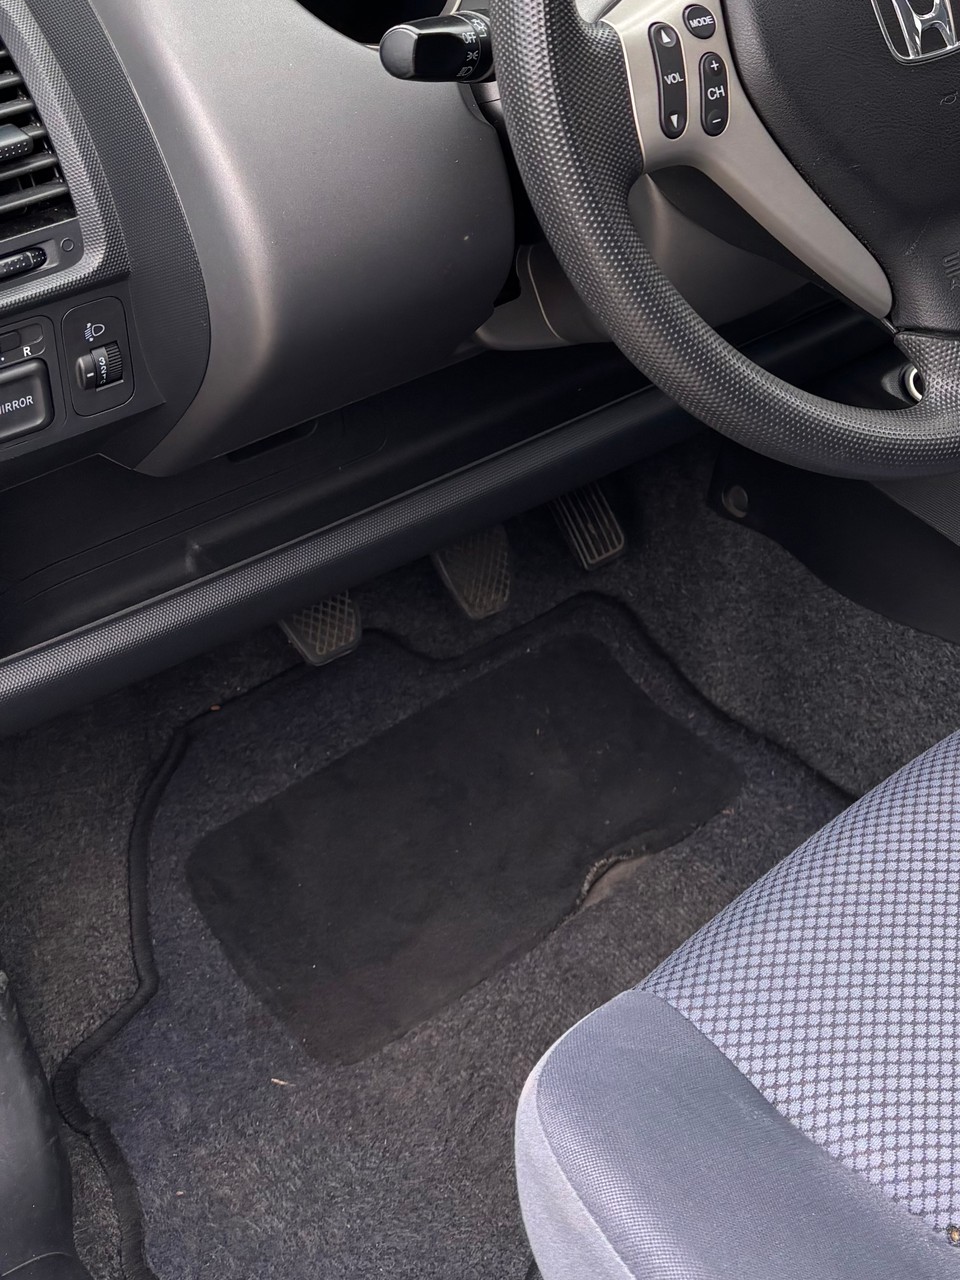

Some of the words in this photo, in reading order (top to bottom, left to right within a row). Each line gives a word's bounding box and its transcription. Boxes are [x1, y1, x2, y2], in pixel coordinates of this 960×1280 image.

[689, 15, 714, 28] MODE
[461, 32, 477, 44] OFF
[664, 72, 684, 85] VOL
[707, 85, 725, 100] CH
[23, 346, 32, 357] R
[98, 356, 106, 366] 3
[100, 365, 107, 374] 2
[0, 395, 33, 414] IRROR
